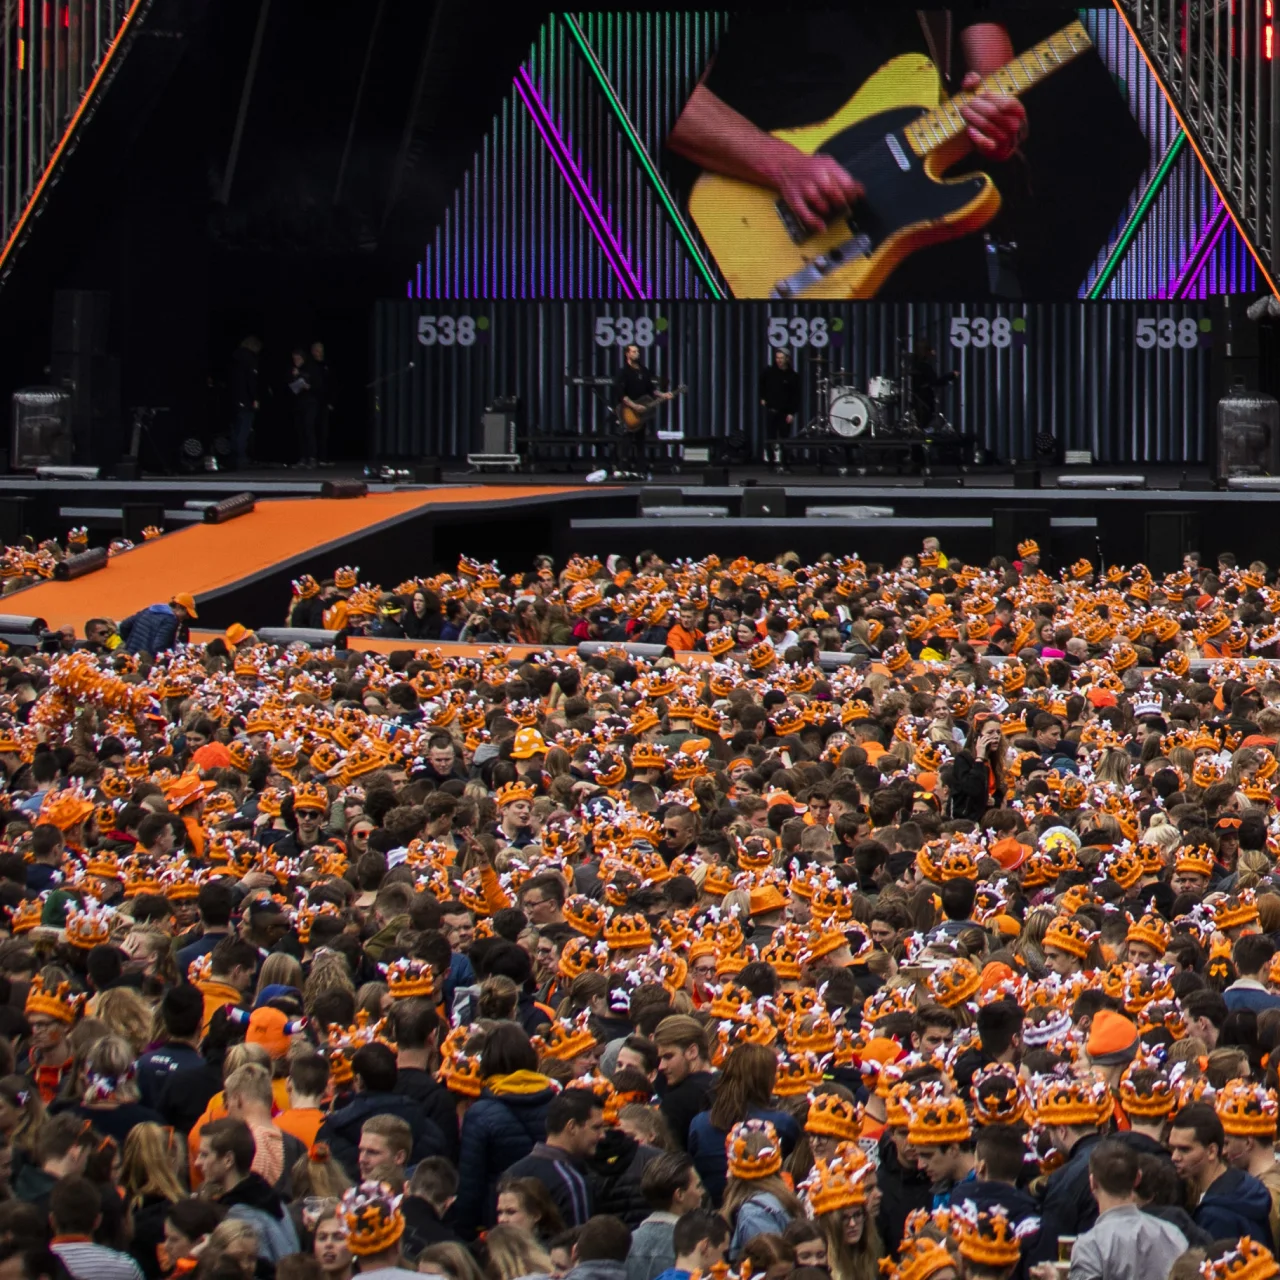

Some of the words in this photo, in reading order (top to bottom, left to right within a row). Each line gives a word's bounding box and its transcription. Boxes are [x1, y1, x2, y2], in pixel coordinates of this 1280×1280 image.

[417, 315, 476, 347] 538
[595, 316, 654, 347] 538
[768, 317, 829, 348] 538
[950, 317, 1012, 348] 538
[1136, 317, 1198, 349] 538
